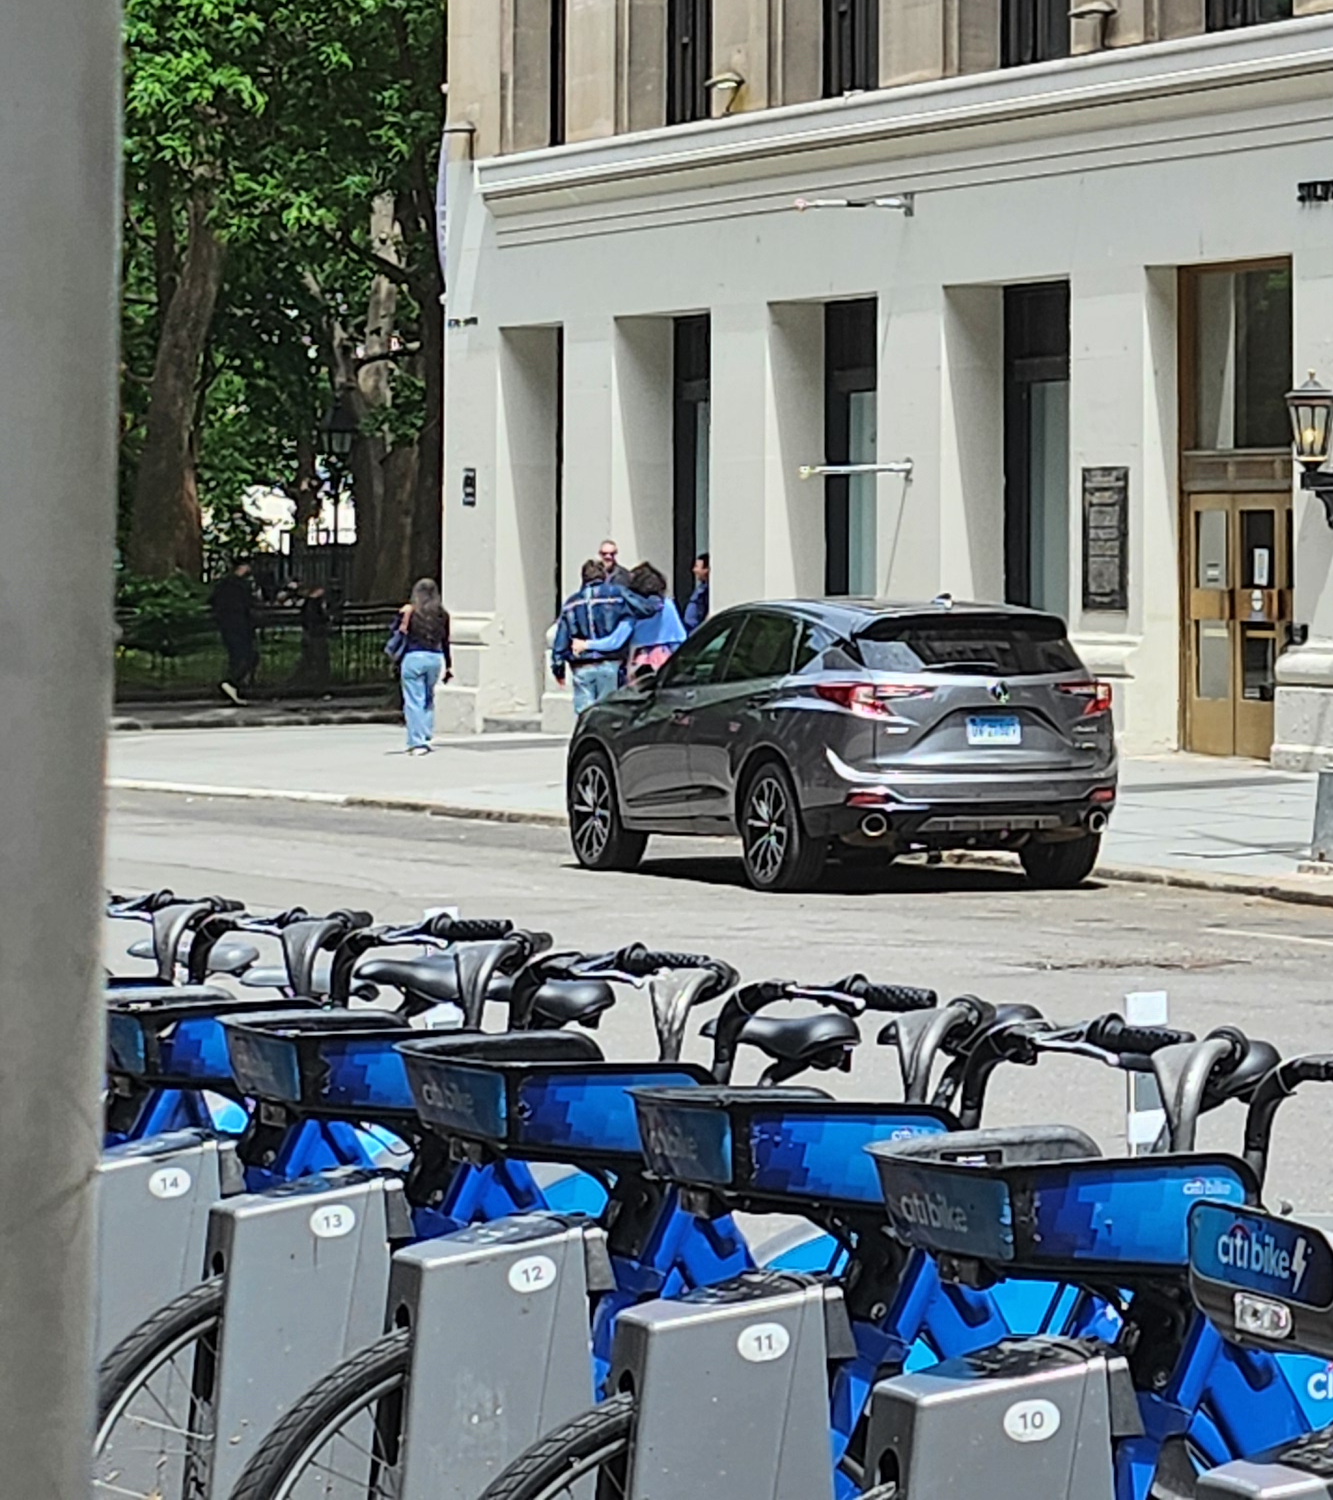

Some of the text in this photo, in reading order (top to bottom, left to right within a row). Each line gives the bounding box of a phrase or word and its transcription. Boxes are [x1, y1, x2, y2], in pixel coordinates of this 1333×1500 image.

[160, 1176, 179, 1190] 14
[323, 1214, 343, 1229] 13
[1218, 1230, 1290, 1279] citi bike
[521, 1266, 543, 1283] 12
[754, 1334, 774, 1351] 11
[1020, 1411, 1044, 1429] 10
